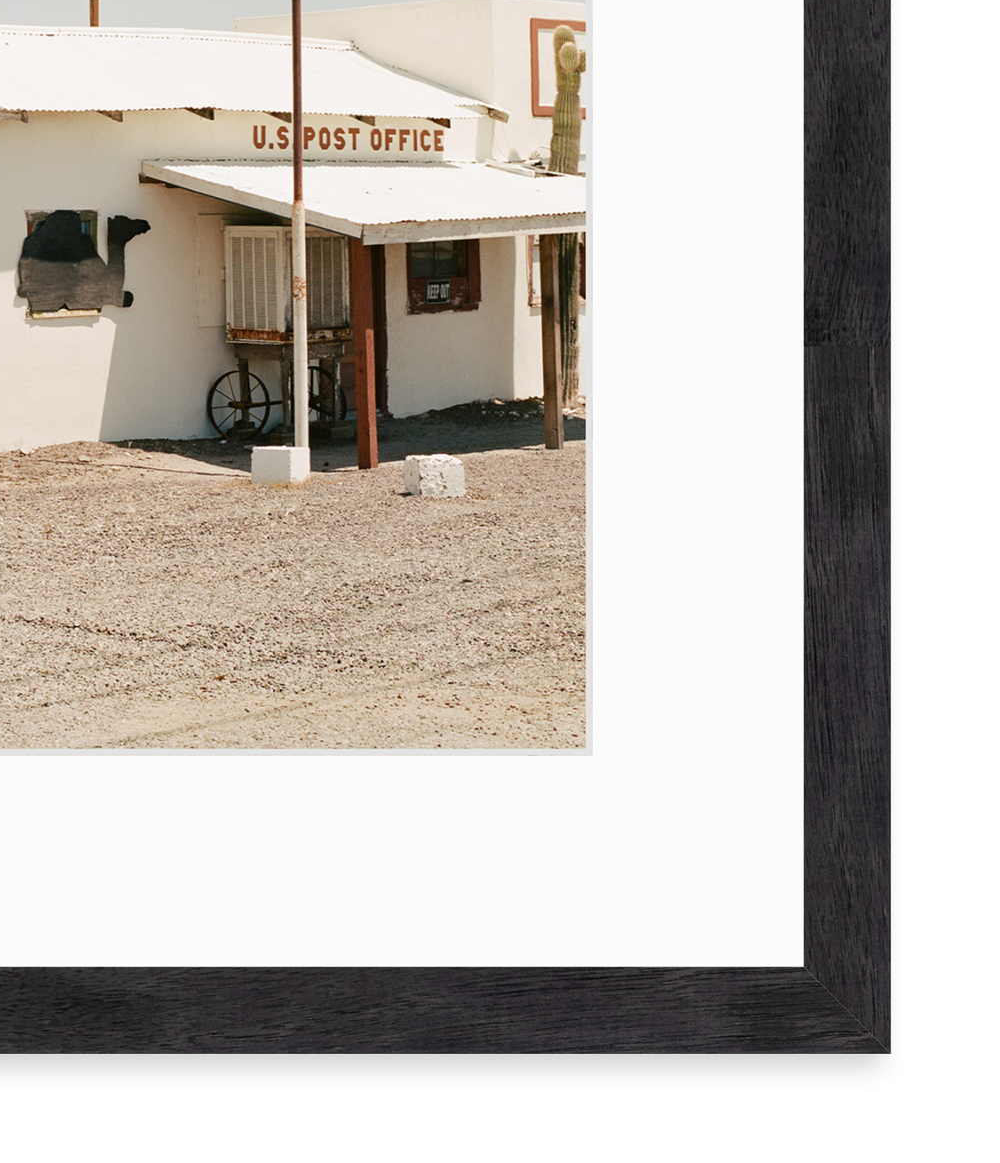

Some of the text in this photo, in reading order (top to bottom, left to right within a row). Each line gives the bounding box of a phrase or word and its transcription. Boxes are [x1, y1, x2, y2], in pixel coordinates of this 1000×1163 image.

[253, 125, 445, 152] U.S POST OFFICE
[427, 283, 450, 300] KEEP OUT
